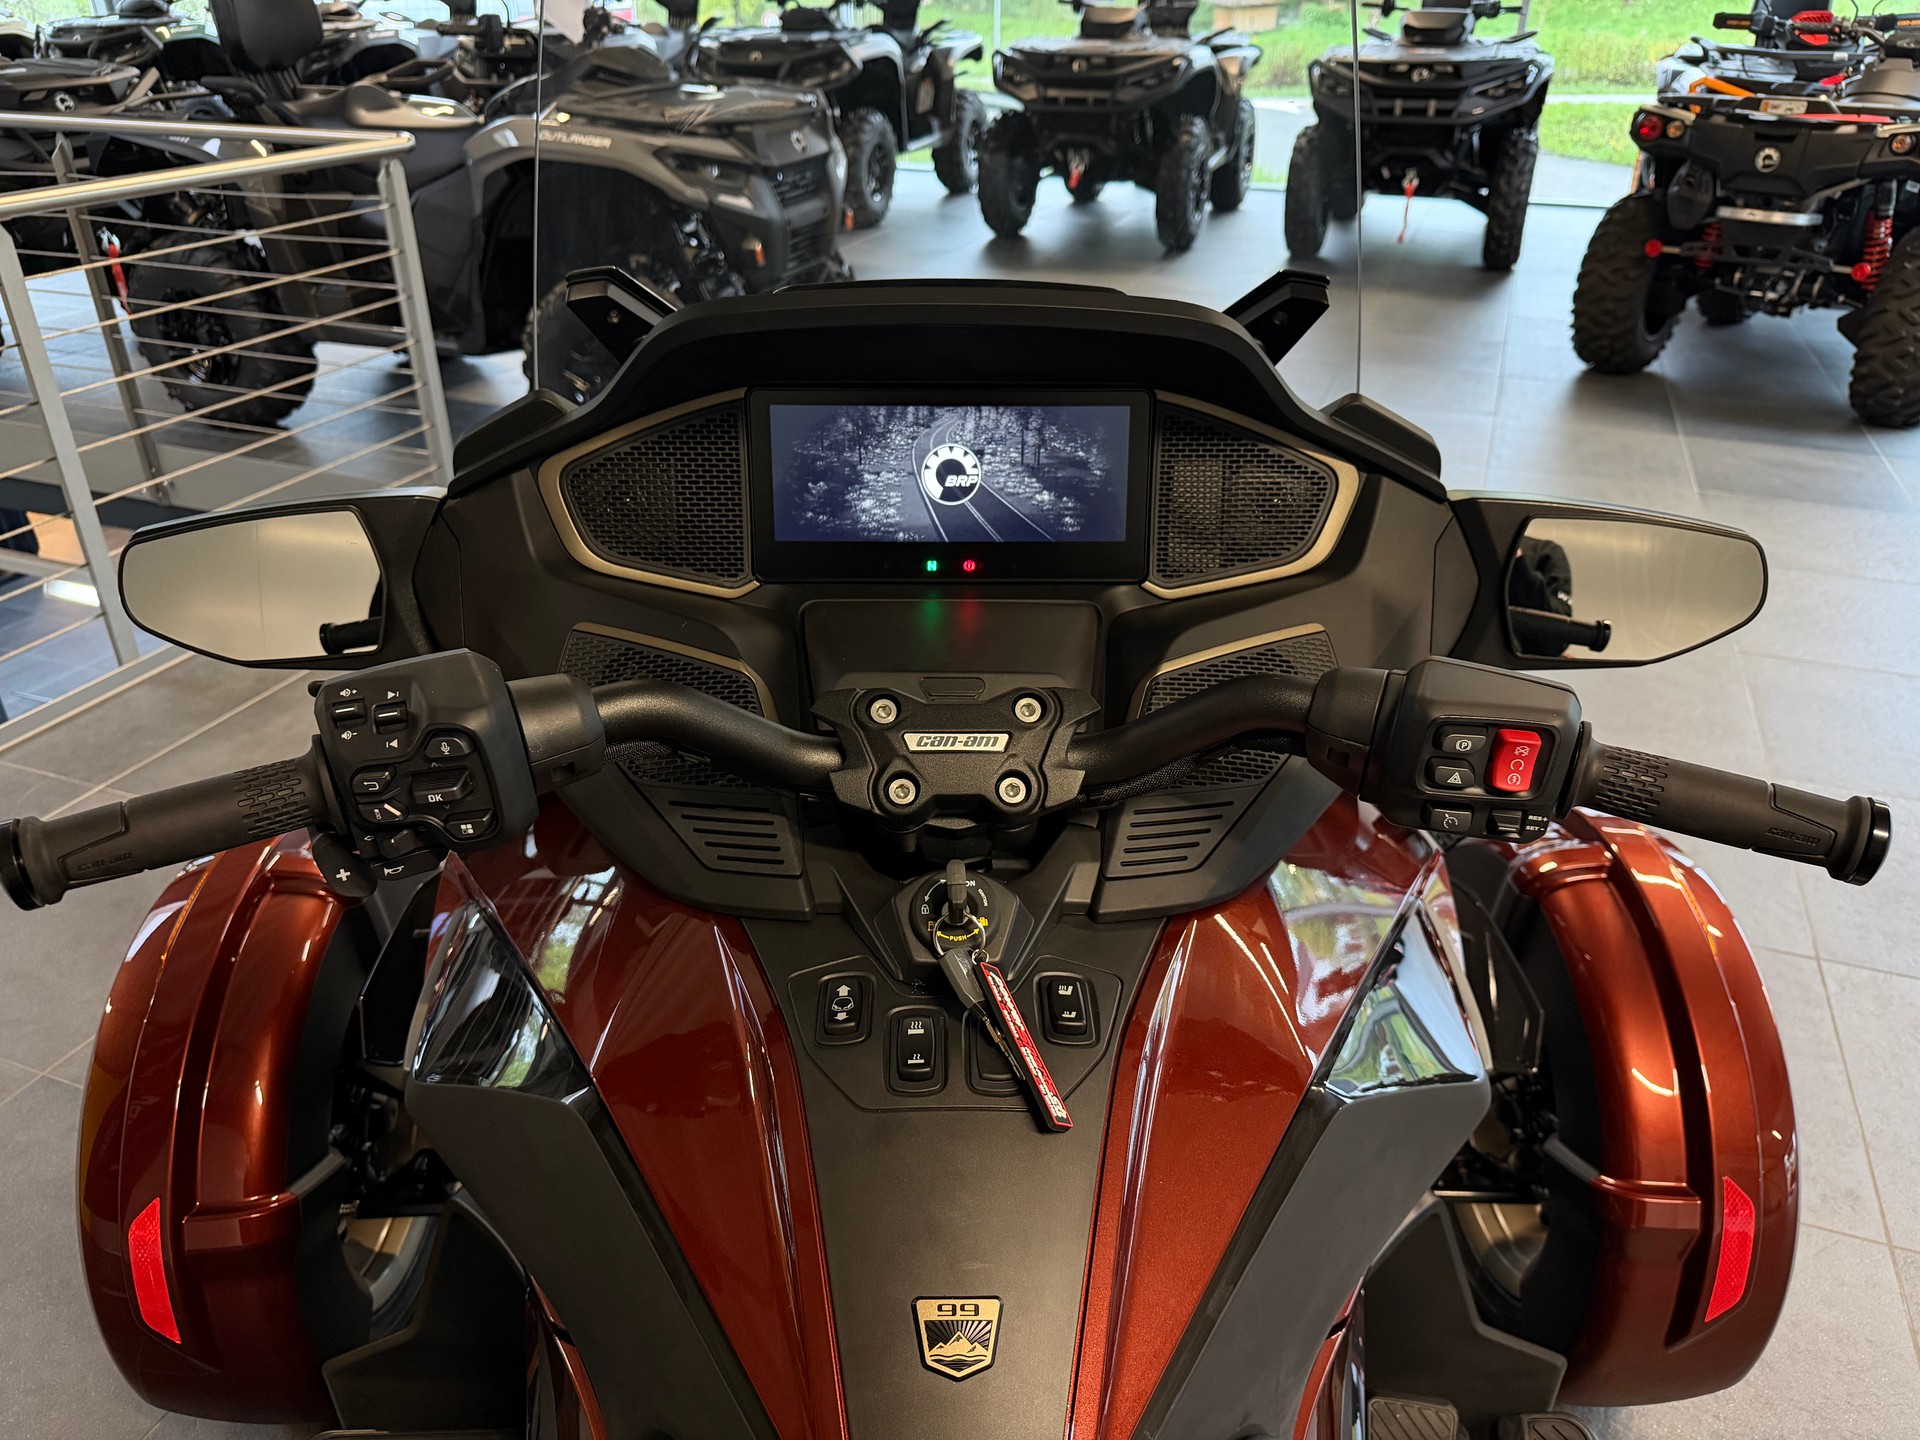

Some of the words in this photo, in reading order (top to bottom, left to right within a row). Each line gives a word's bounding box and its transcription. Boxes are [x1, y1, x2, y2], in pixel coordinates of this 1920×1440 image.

[540, 129, 612, 149] OUTLANDER
[945, 475, 978, 487] BRP
[916, 736, 999, 747] can-am
[428, 794, 443, 802] OK
[937, 1304, 980, 1316] 99
